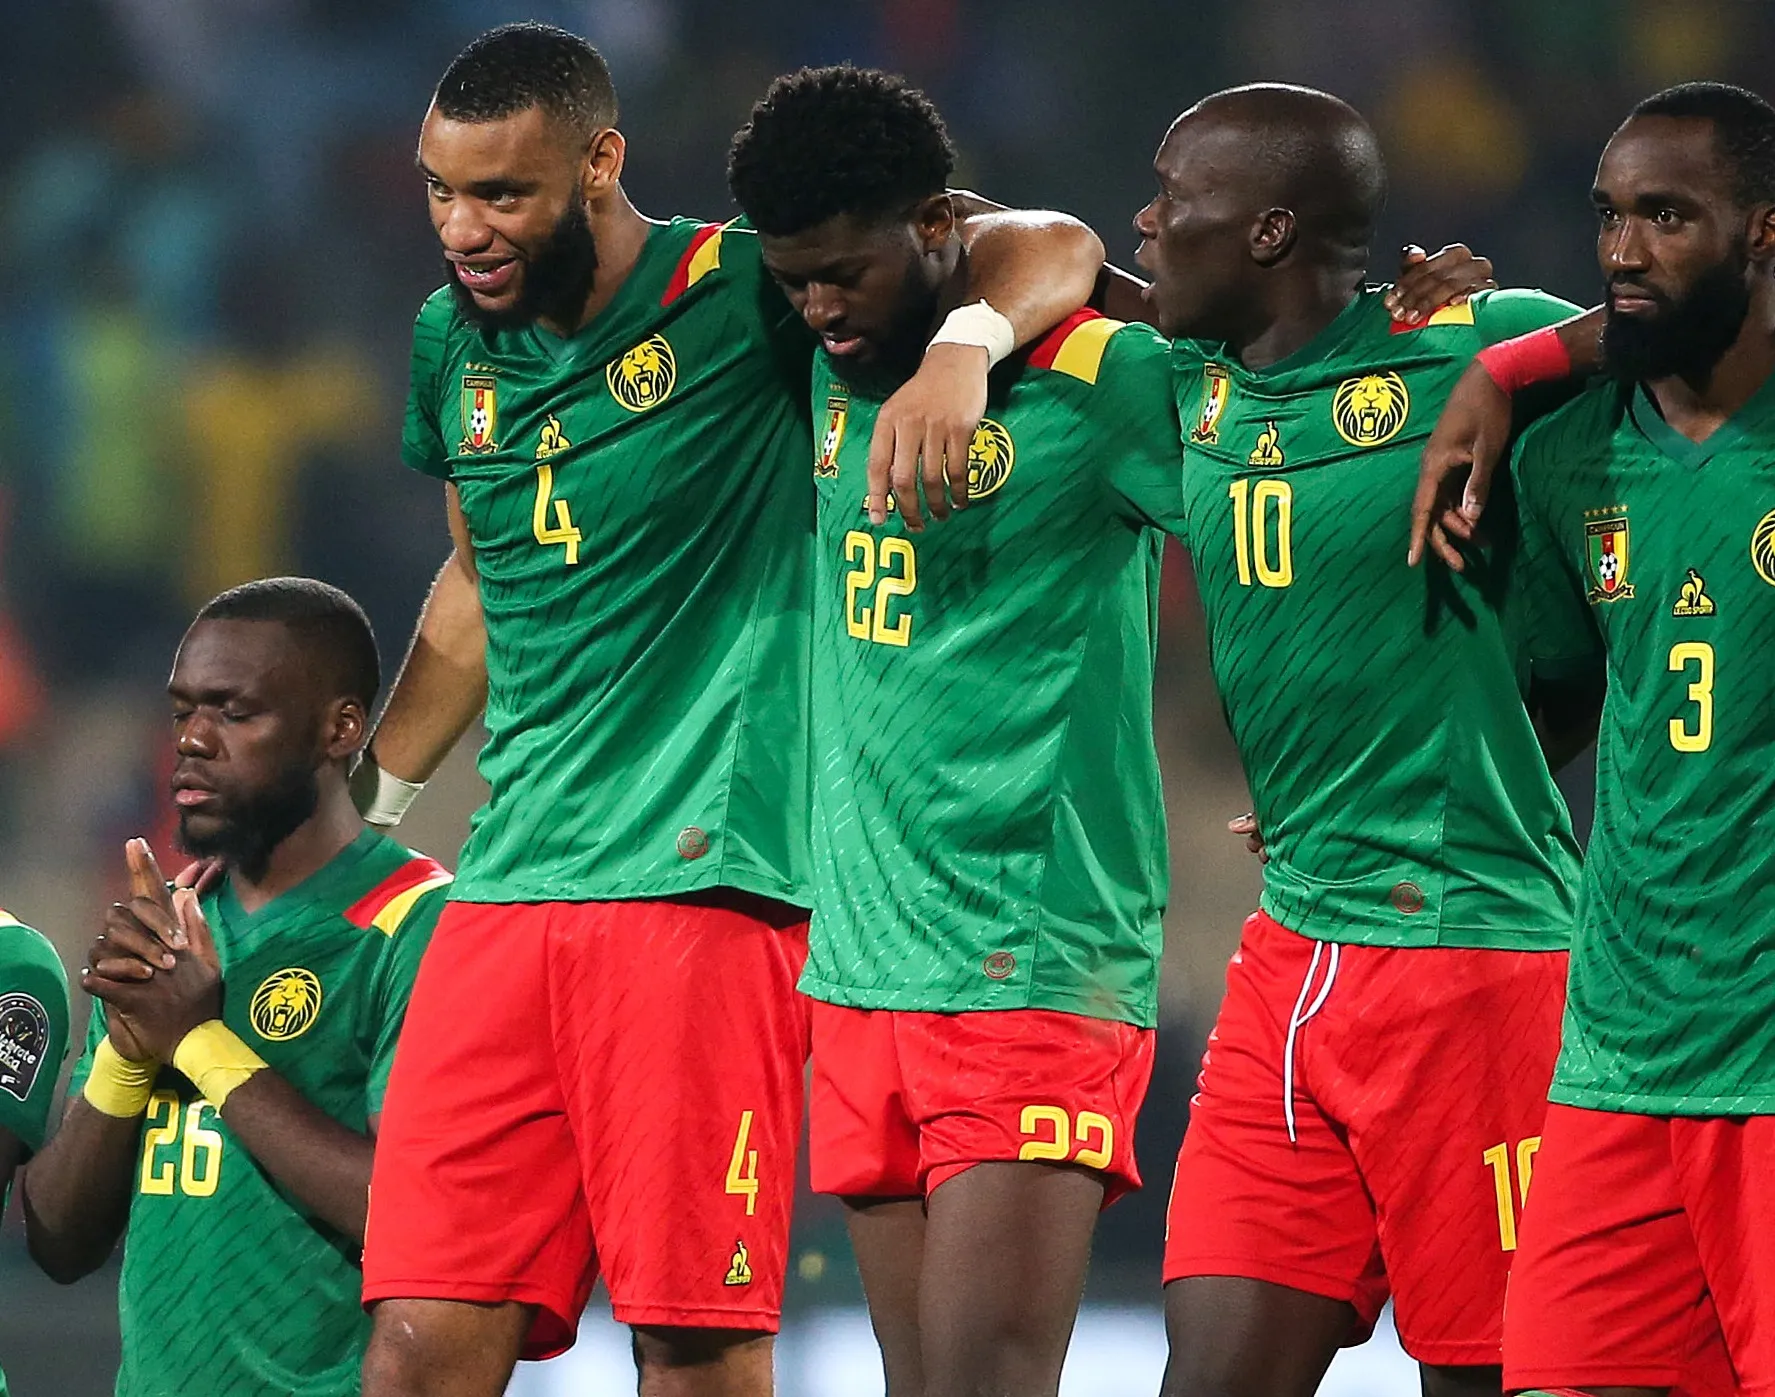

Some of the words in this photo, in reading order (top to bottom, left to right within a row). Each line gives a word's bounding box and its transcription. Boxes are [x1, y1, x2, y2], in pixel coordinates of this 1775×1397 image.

[533, 464, 582, 565] 4
[1228, 478, 1293, 588] 10
[845, 530, 916, 647] 22
[1669, 642, 1714, 752] 3
[0, 1033, 37, 1065] lebrate
[140, 1089, 223, 1197] 26
[725, 1110, 759, 1216] 4
